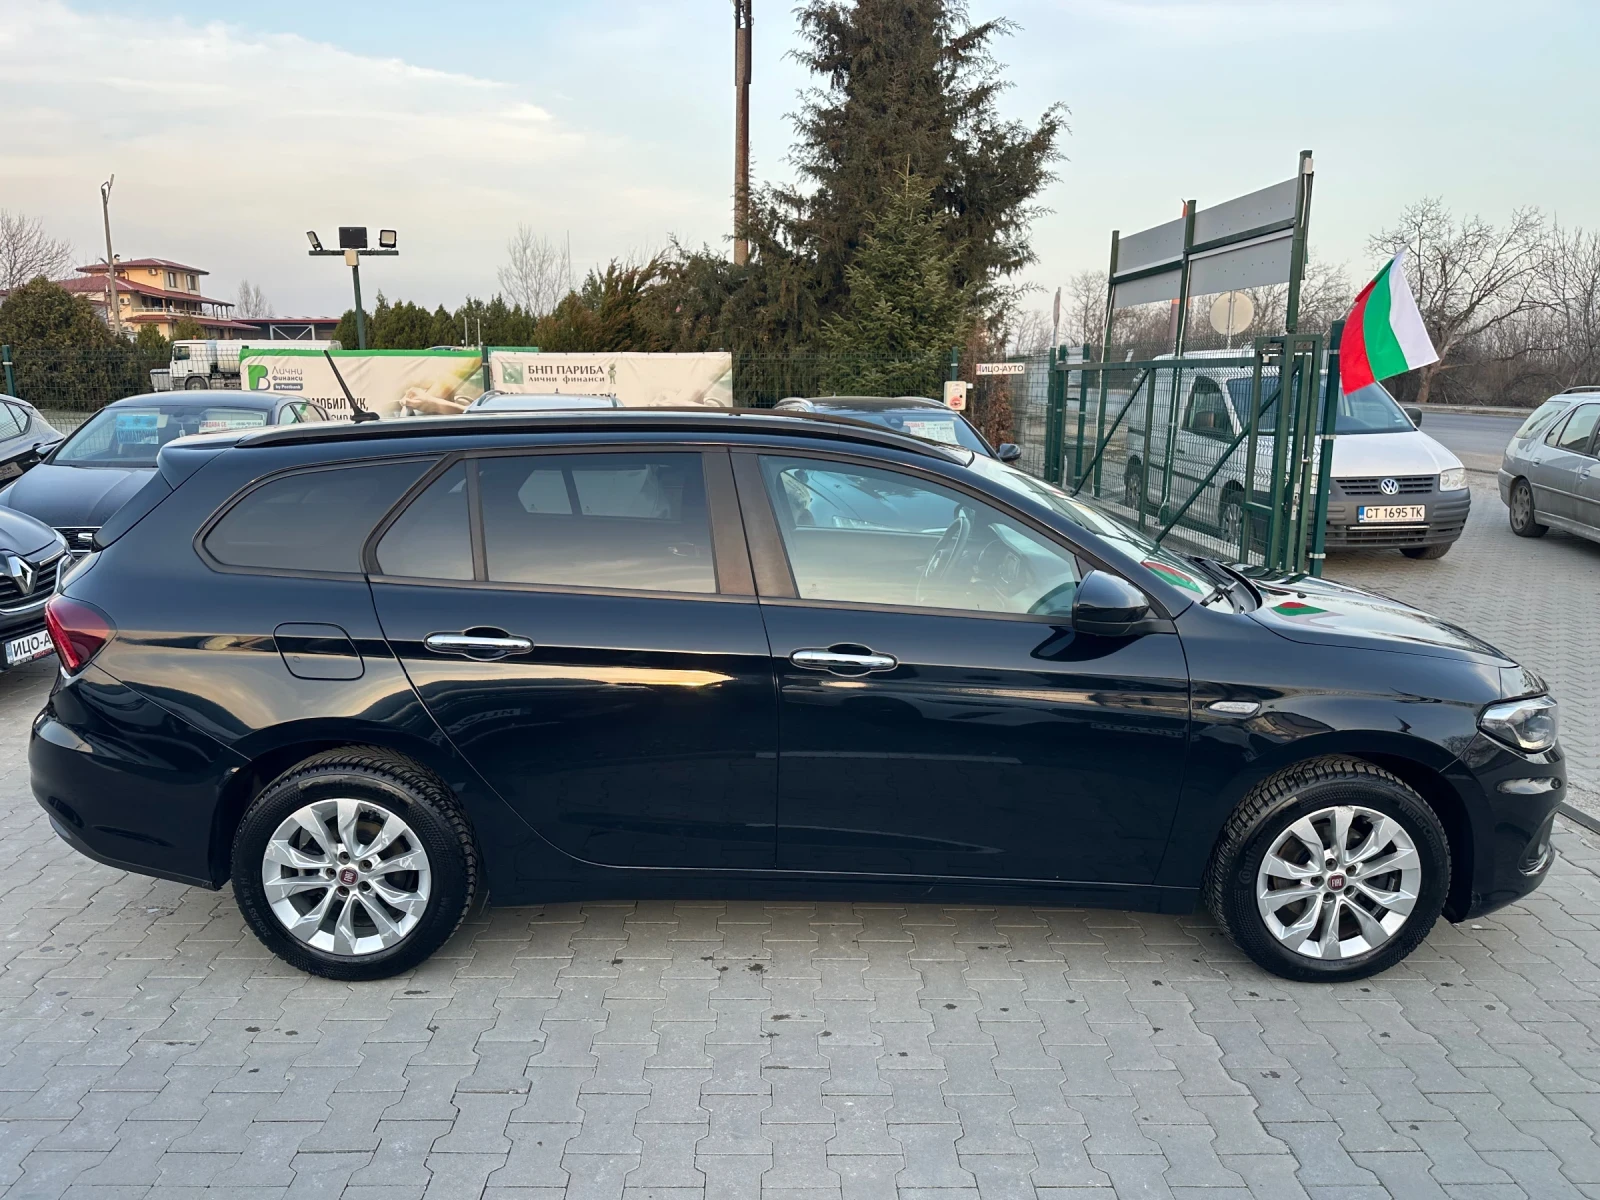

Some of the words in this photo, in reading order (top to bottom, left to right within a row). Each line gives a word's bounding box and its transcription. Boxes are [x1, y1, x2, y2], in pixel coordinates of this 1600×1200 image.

[271, 366, 303, 375] Лични
[528, 365, 553, 375] БНП
[556, 365, 604, 375] ПАРИБА
[981, 364, 1024, 374] ИЦО-АУТО
[562, 375, 605, 384] финанси
[1365, 508, 1380, 519] CT
[1383, 507, 1408, 518] 1695
[1410, 507, 1423, 518] TK
